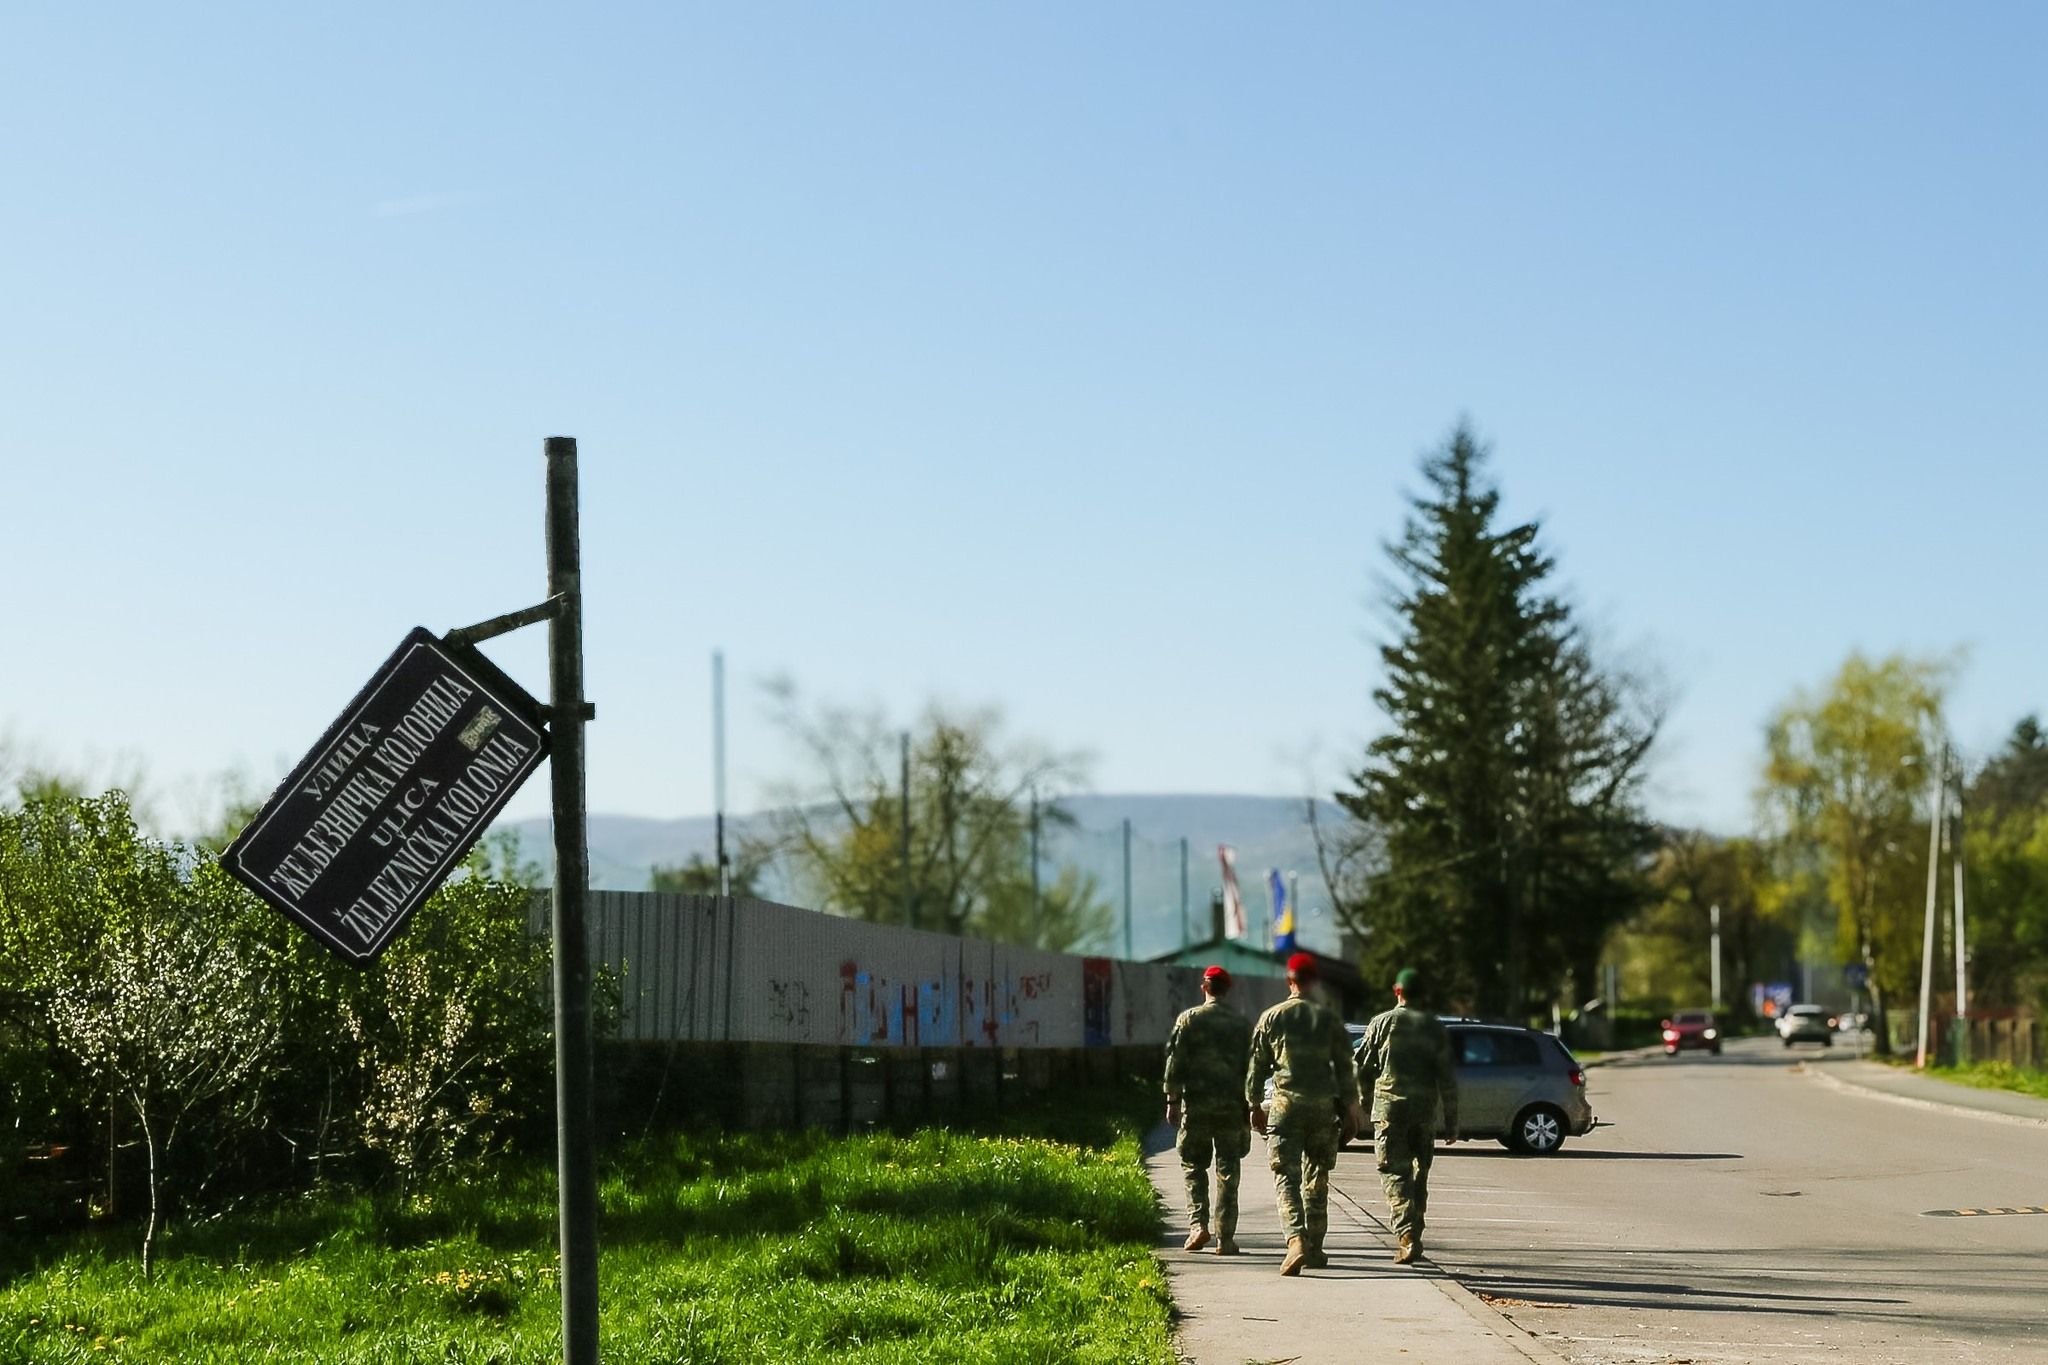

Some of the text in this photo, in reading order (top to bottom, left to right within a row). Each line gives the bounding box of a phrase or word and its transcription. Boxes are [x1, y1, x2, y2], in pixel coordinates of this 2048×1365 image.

[269, 674, 473, 900] ЖЕЉЕЗНИЧКА КОЛОНИЈА
[303, 723, 381, 801] УЛИЦА
[370, 778, 439, 846] ULICA
[331, 817, 459, 944] ŽELJEZNIČKA
[435, 731, 530, 829] KOLONIJA
